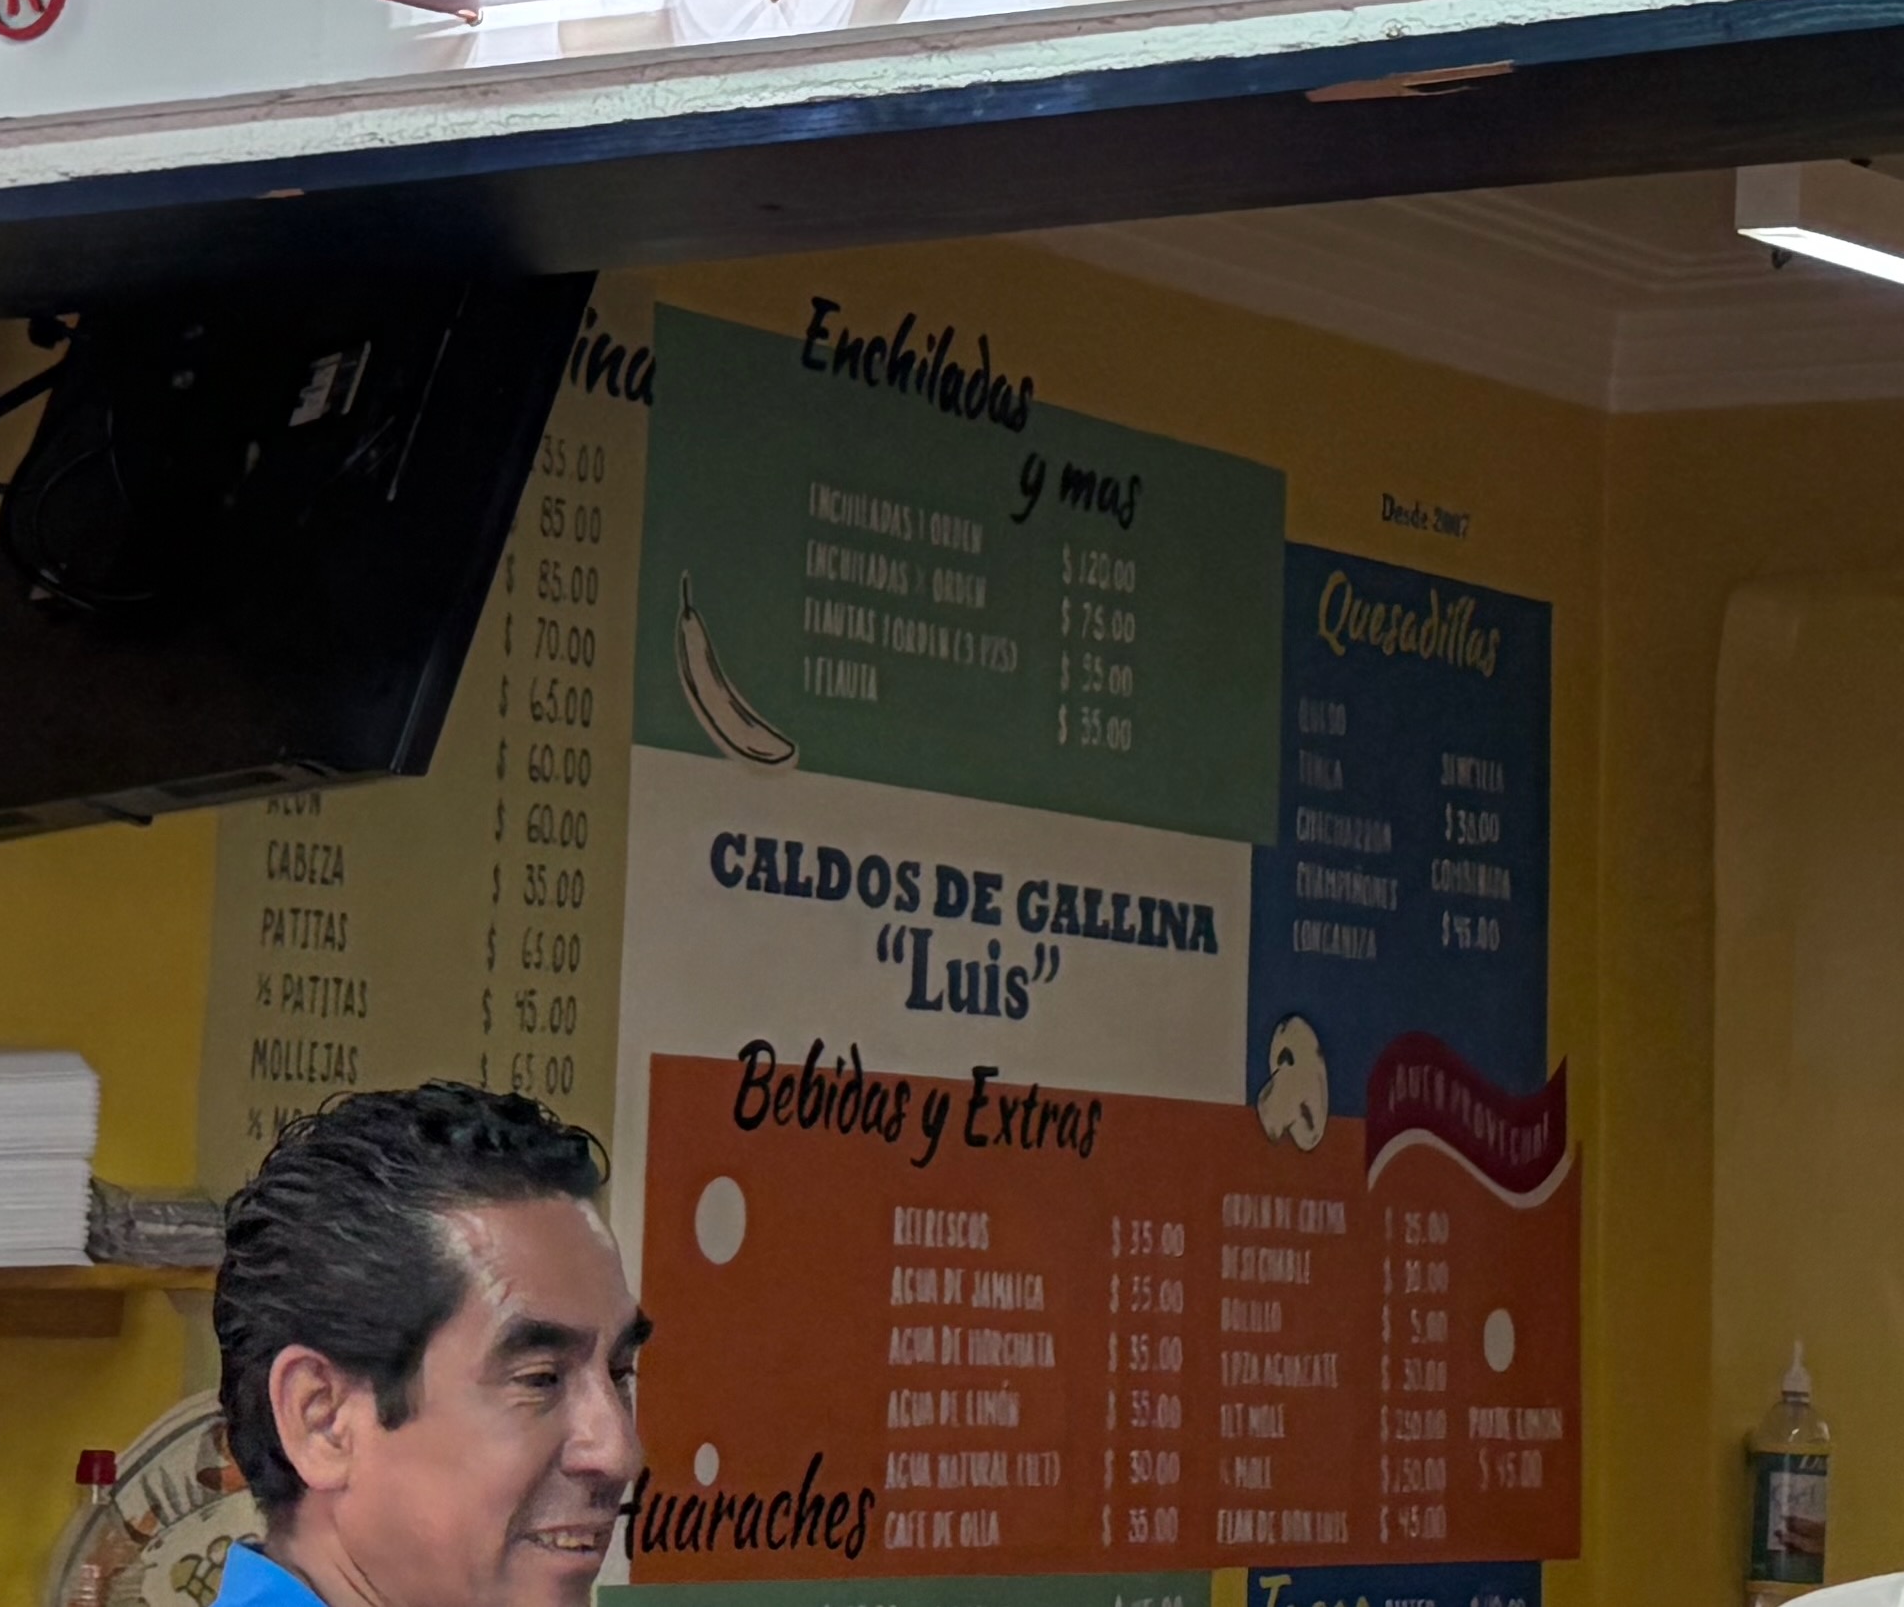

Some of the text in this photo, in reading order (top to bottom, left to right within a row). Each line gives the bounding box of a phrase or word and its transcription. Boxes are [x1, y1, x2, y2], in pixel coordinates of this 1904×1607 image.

[801, 296, 1034, 432] Enchiladas
[809, 481, 913, 543] ENCHILADAS
[930, 511, 984, 555] ORDEN
[1010, 452, 1141, 530] y mas
[806, 539, 910, 598] ENCHILADAS
[932, 567, 987, 610] ORDEN
[804, 596, 877, 644] FLAUTAS
[1317, 569, 1502, 679] Quesadillas
[815, 656, 879, 702] FLAUTA
[266, 839, 345, 886] CABEZA
[523, 864, 585, 909] 35.00
[709, 830, 1219, 955] CALDOS DE GALLINA
[260, 907, 349, 952] PATITAS
[281, 972, 368, 1019] PATITAS
[250, 1038, 359, 1086] MOLLEJAS
[733, 1037, 1103, 1169] Bebidas y Extras
